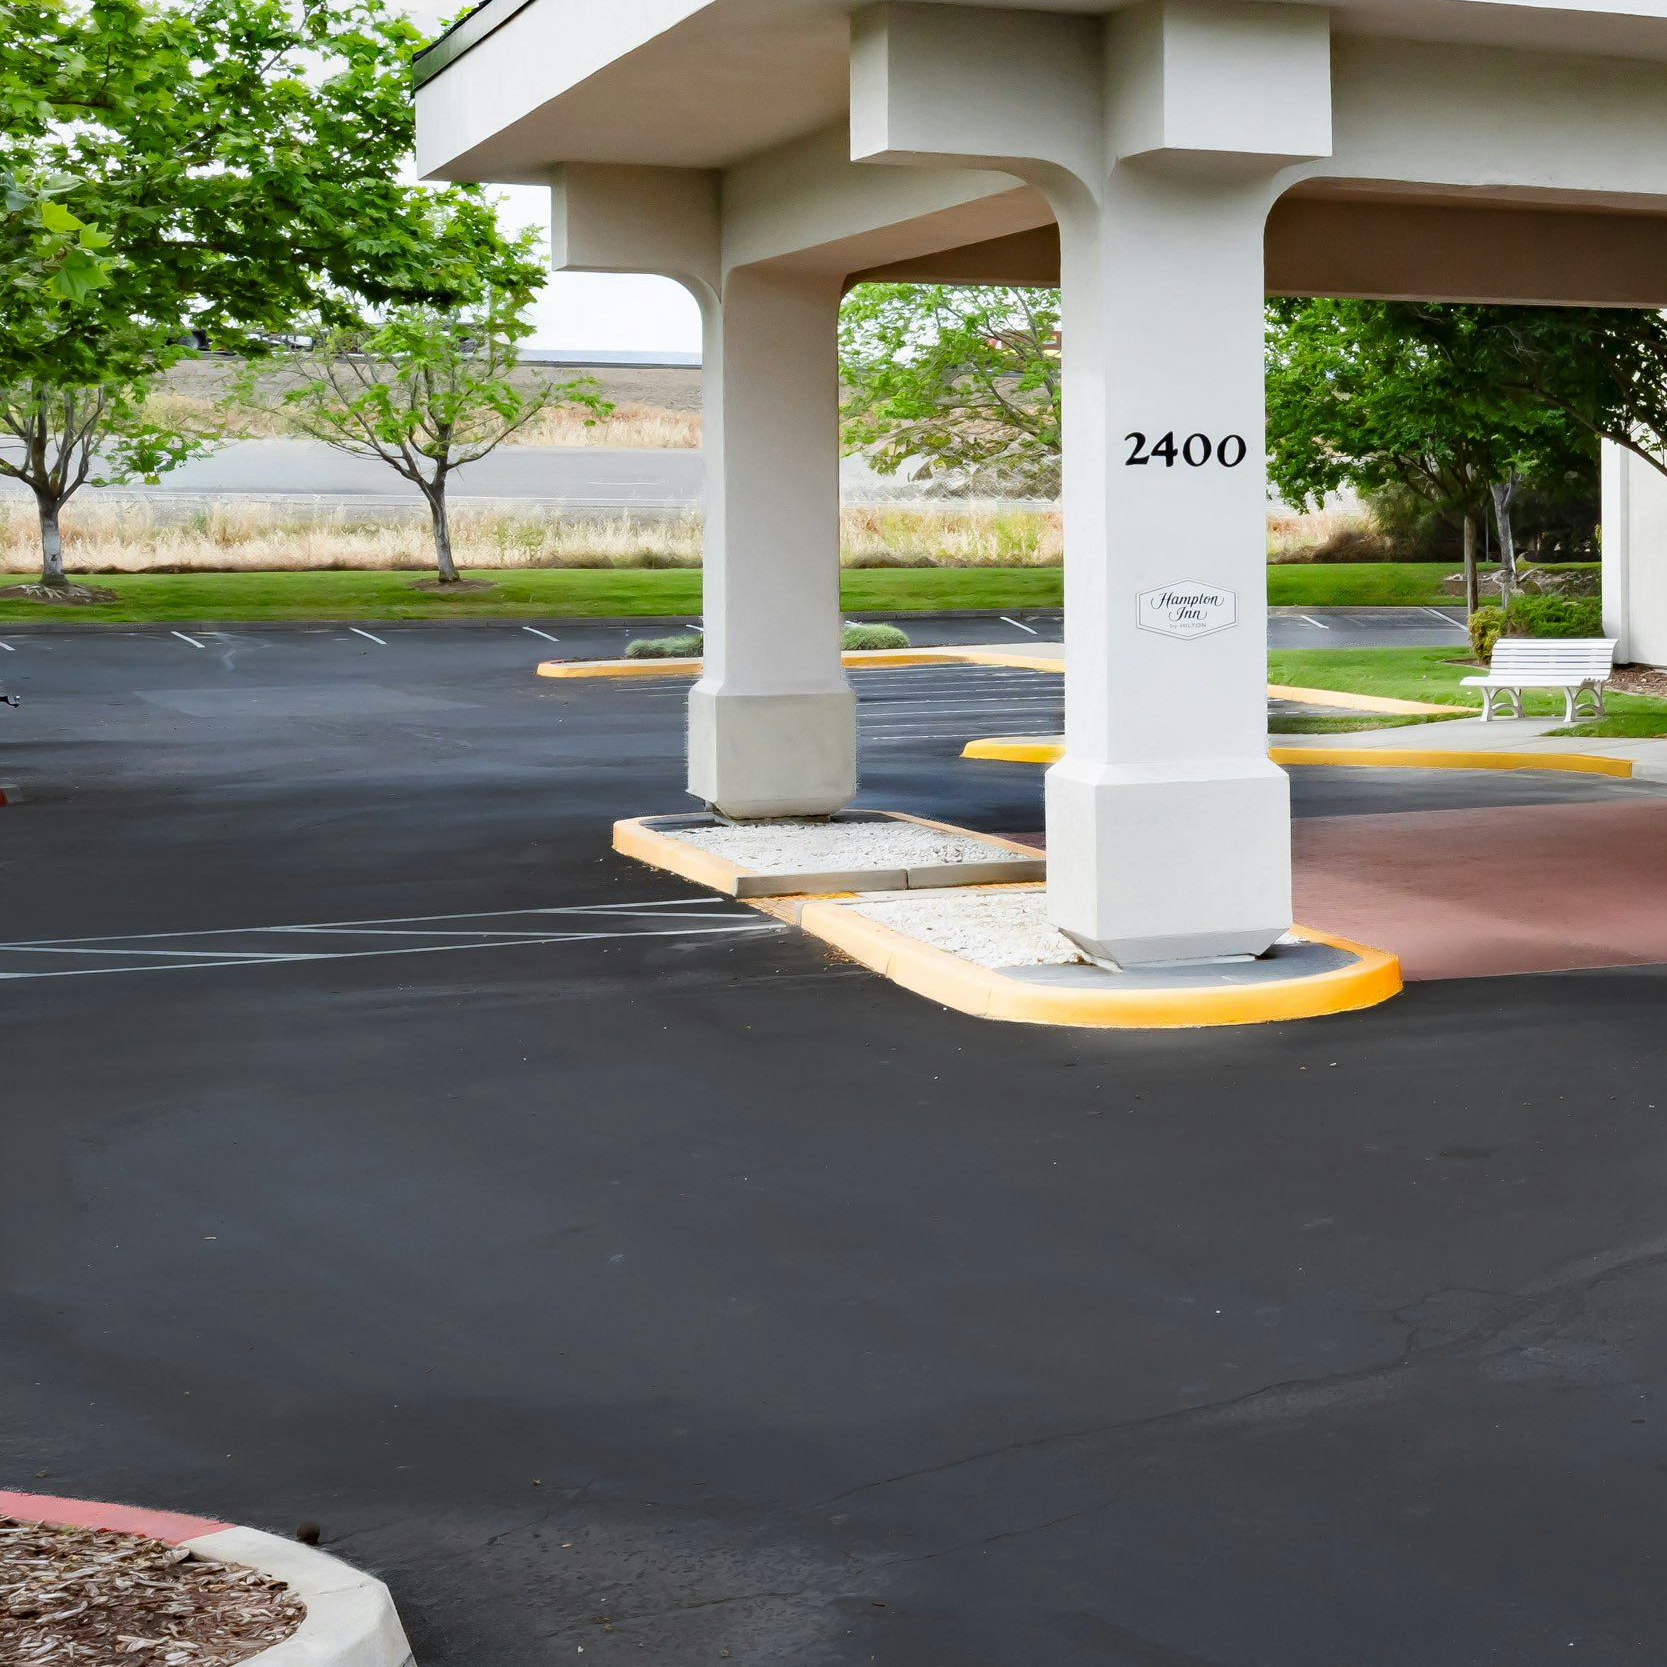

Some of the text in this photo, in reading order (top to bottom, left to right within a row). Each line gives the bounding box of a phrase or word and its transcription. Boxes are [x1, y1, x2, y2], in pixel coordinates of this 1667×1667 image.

[1124, 430, 1247, 468] 2400
[1150, 592, 1225, 610] Hampton
[1168, 606, 1208, 622] Inn
